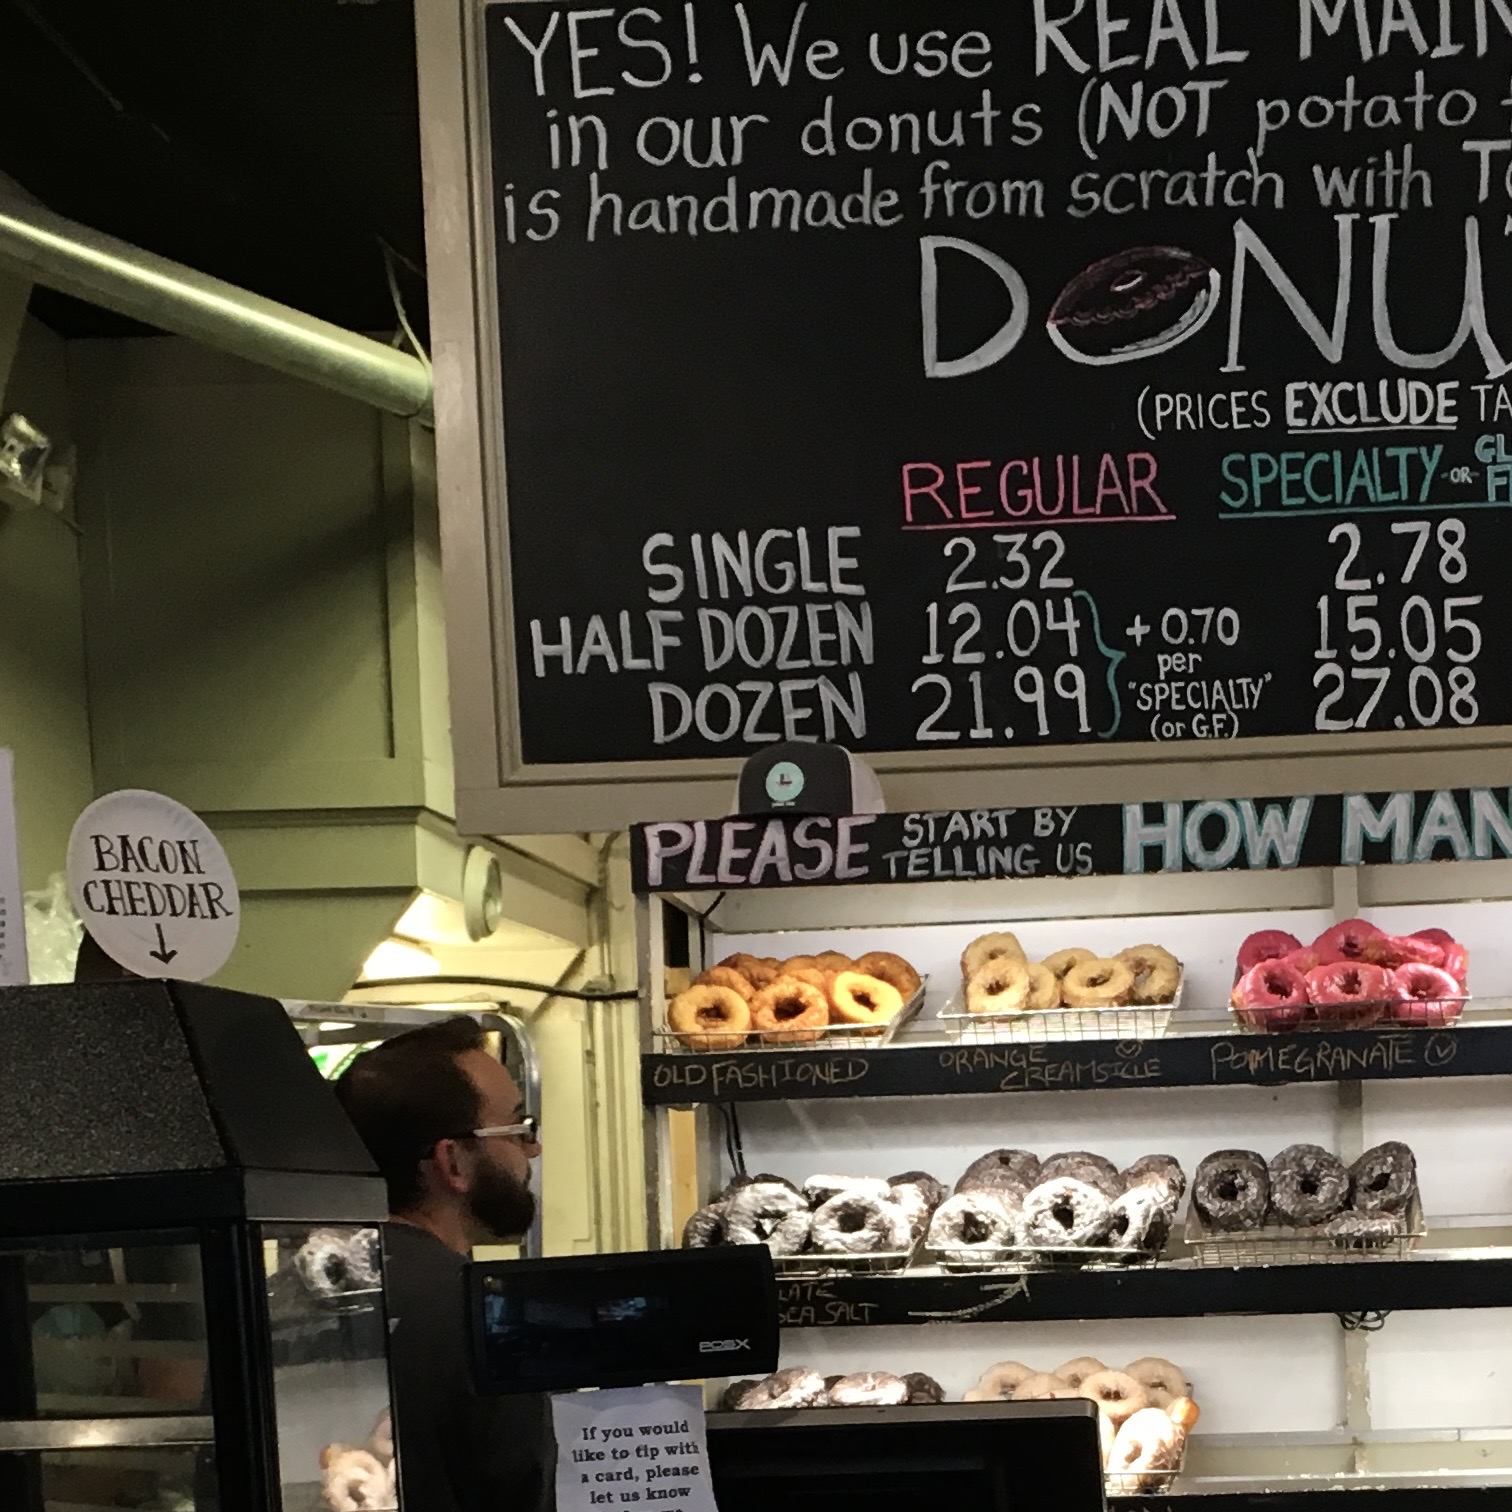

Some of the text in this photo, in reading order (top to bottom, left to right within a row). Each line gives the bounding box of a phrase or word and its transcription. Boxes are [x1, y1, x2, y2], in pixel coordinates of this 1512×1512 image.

[504, 5, 704, 98] YES!
[736, 3, 845, 88] We
[869, 29, 993, 79] use
[1034, 0, 1250, 76] REAL
[547, 108, 607, 171] in
[636, 110, 769, 168] our
[801, 88, 1045, 157] donuts
[1078, 77, 1230, 160] (NOT
[1256, 75, 1478, 156] potato
[503, 183, 560, 244] is
[587, 171, 905, 240] handmade
[919, 160, 1046, 220] from
[1066, 148, 1286, 216] scratch
[1312, 142, 1433, 209] with
[1135, 386, 1273, 441] (PRICES
[1286, 377, 1458, 430] EXCLUDE
[902, 452, 1169, 518] REGULAR
[1218, 442, 1445, 510] SPECIALTY
[640, 517, 1469, 600] SINGLE 2.32 2.78
[530, 594, 1484, 680] HALF DOZEN 12.04 15.05
[1156, 648, 1203, 678] per
[648, 665, 1482, 746] DOZEN 21.99 27.08
[1148, 712, 1187, 741] (or
[901, 805, 1080, 848] START BY
[1119, 793, 1316, 874] HOW
[89, 833, 207, 876] BACON
[643, 812, 879, 889] PLEASE
[882, 841, 1094, 880] TELLING US
[82, 878, 235, 921] CHEDDAR
[653, 1056, 870, 1096] OLD FASHIONED
[939, 1044, 1048, 1074] ORANGE
[1210, 1033, 1419, 1081] POMEGRANATE
[818, 1301, 880, 1325] SALT
[572, 1440, 701, 1463] like to tip with
[582, 1420, 690, 1443] If you would
[581, 1463, 701, 1484] a card, please
[589, 1485, 692, 1504] let us know
